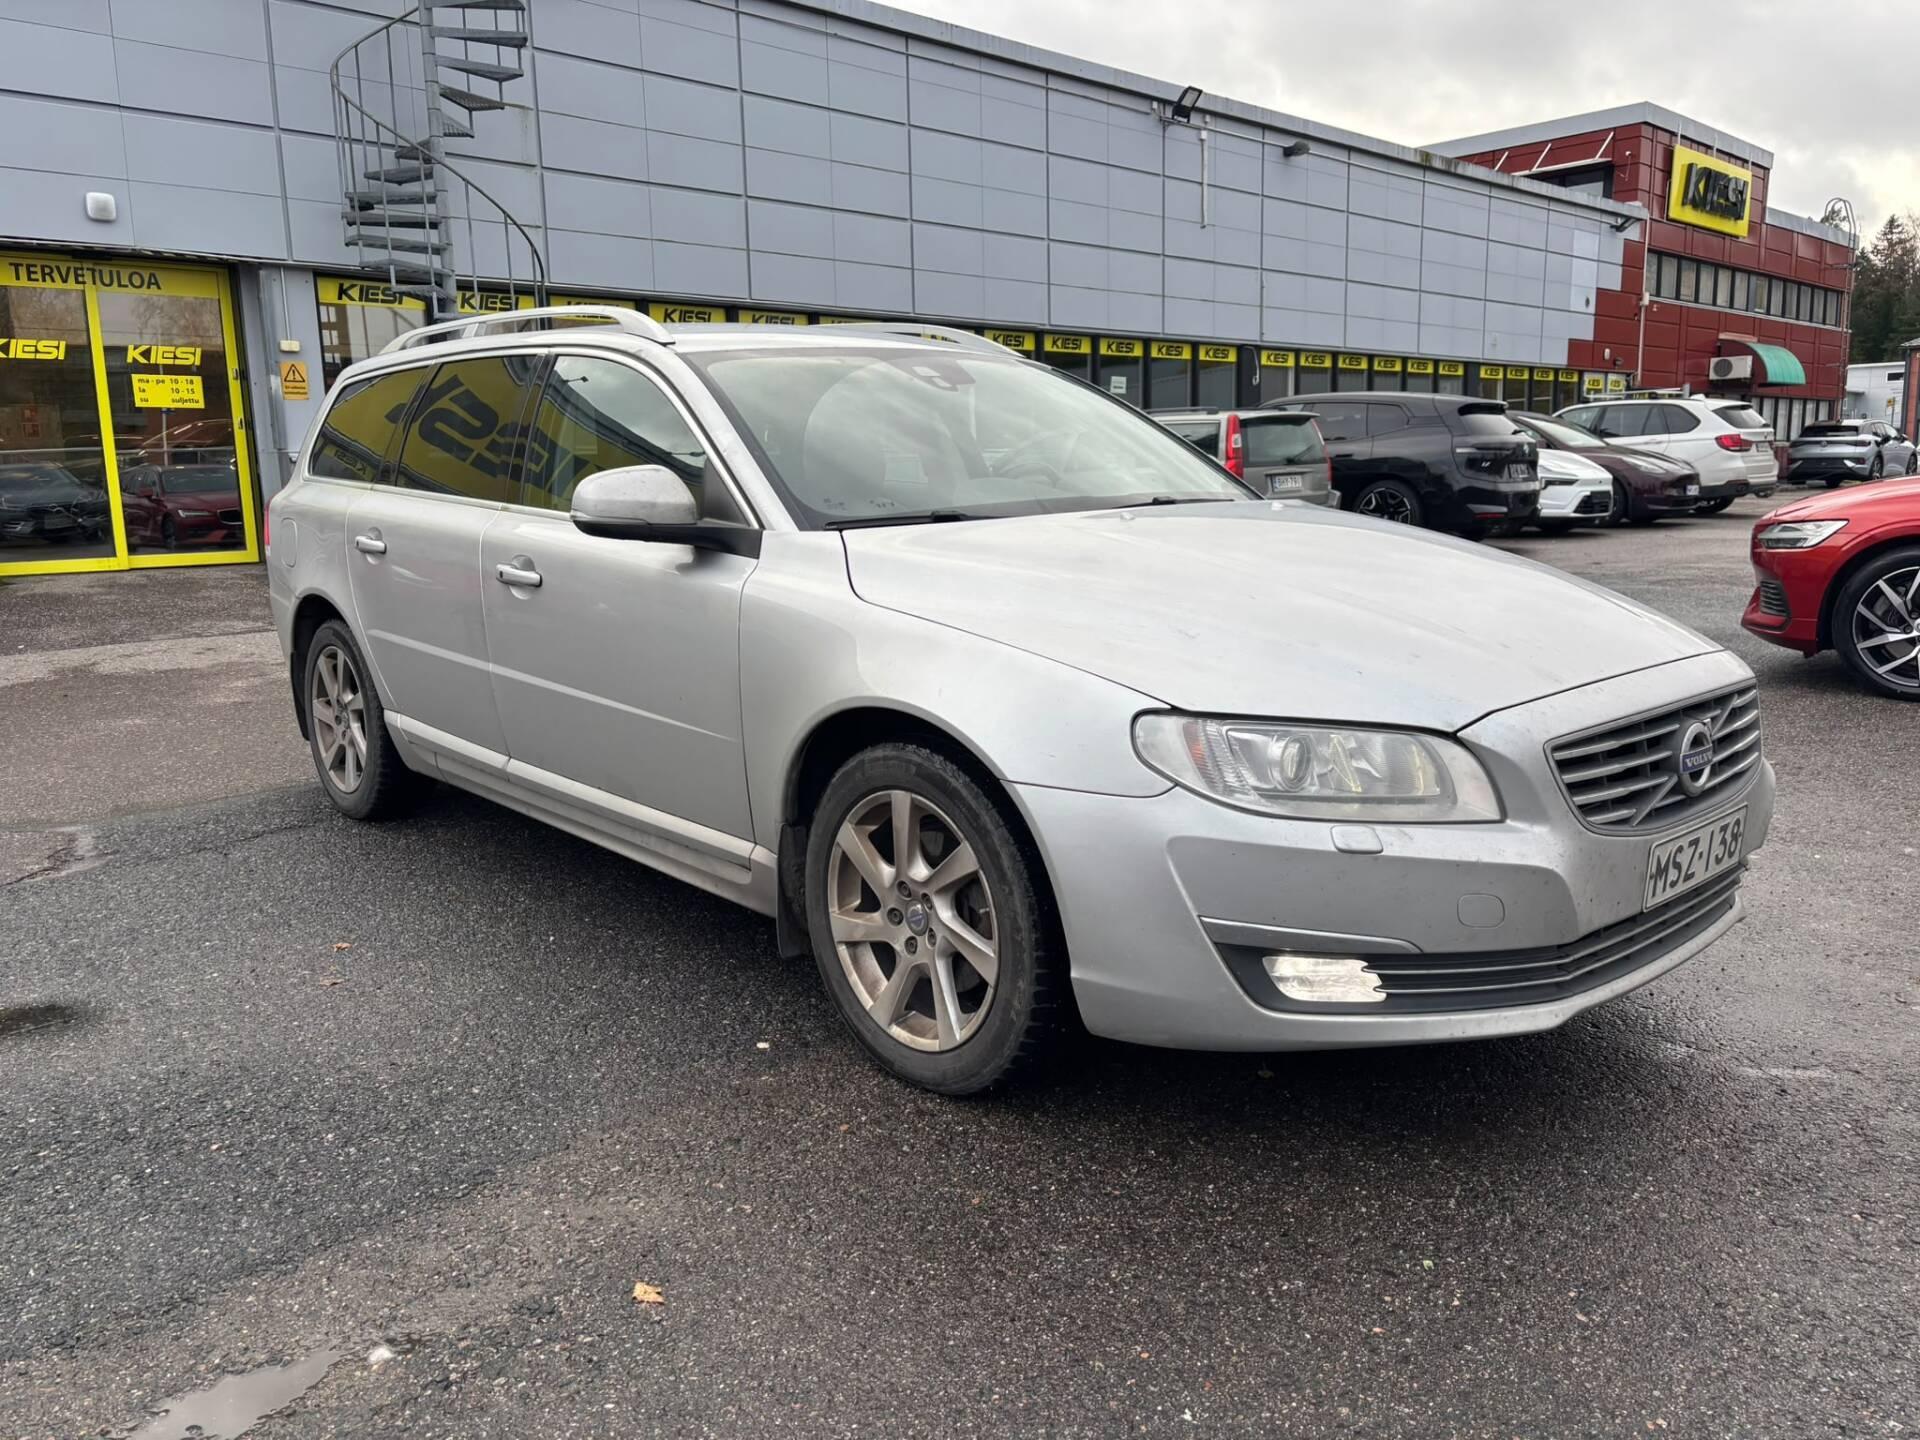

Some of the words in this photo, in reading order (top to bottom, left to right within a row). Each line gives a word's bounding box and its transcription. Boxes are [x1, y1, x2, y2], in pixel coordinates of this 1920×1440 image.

[9, 262, 162, 290] TERVETULOA
[664, 308, 712, 323] KIESI
[1052, 335, 1083, 350] KIESI
[1107, 340, 1135, 353] KIESI
[126, 344, 202, 366] KIESI
[1157, 344, 1184, 357] KIESI
[1204, 347, 1230, 360] KIESI
[1651, 818, 1742, 898] MSZ-138
